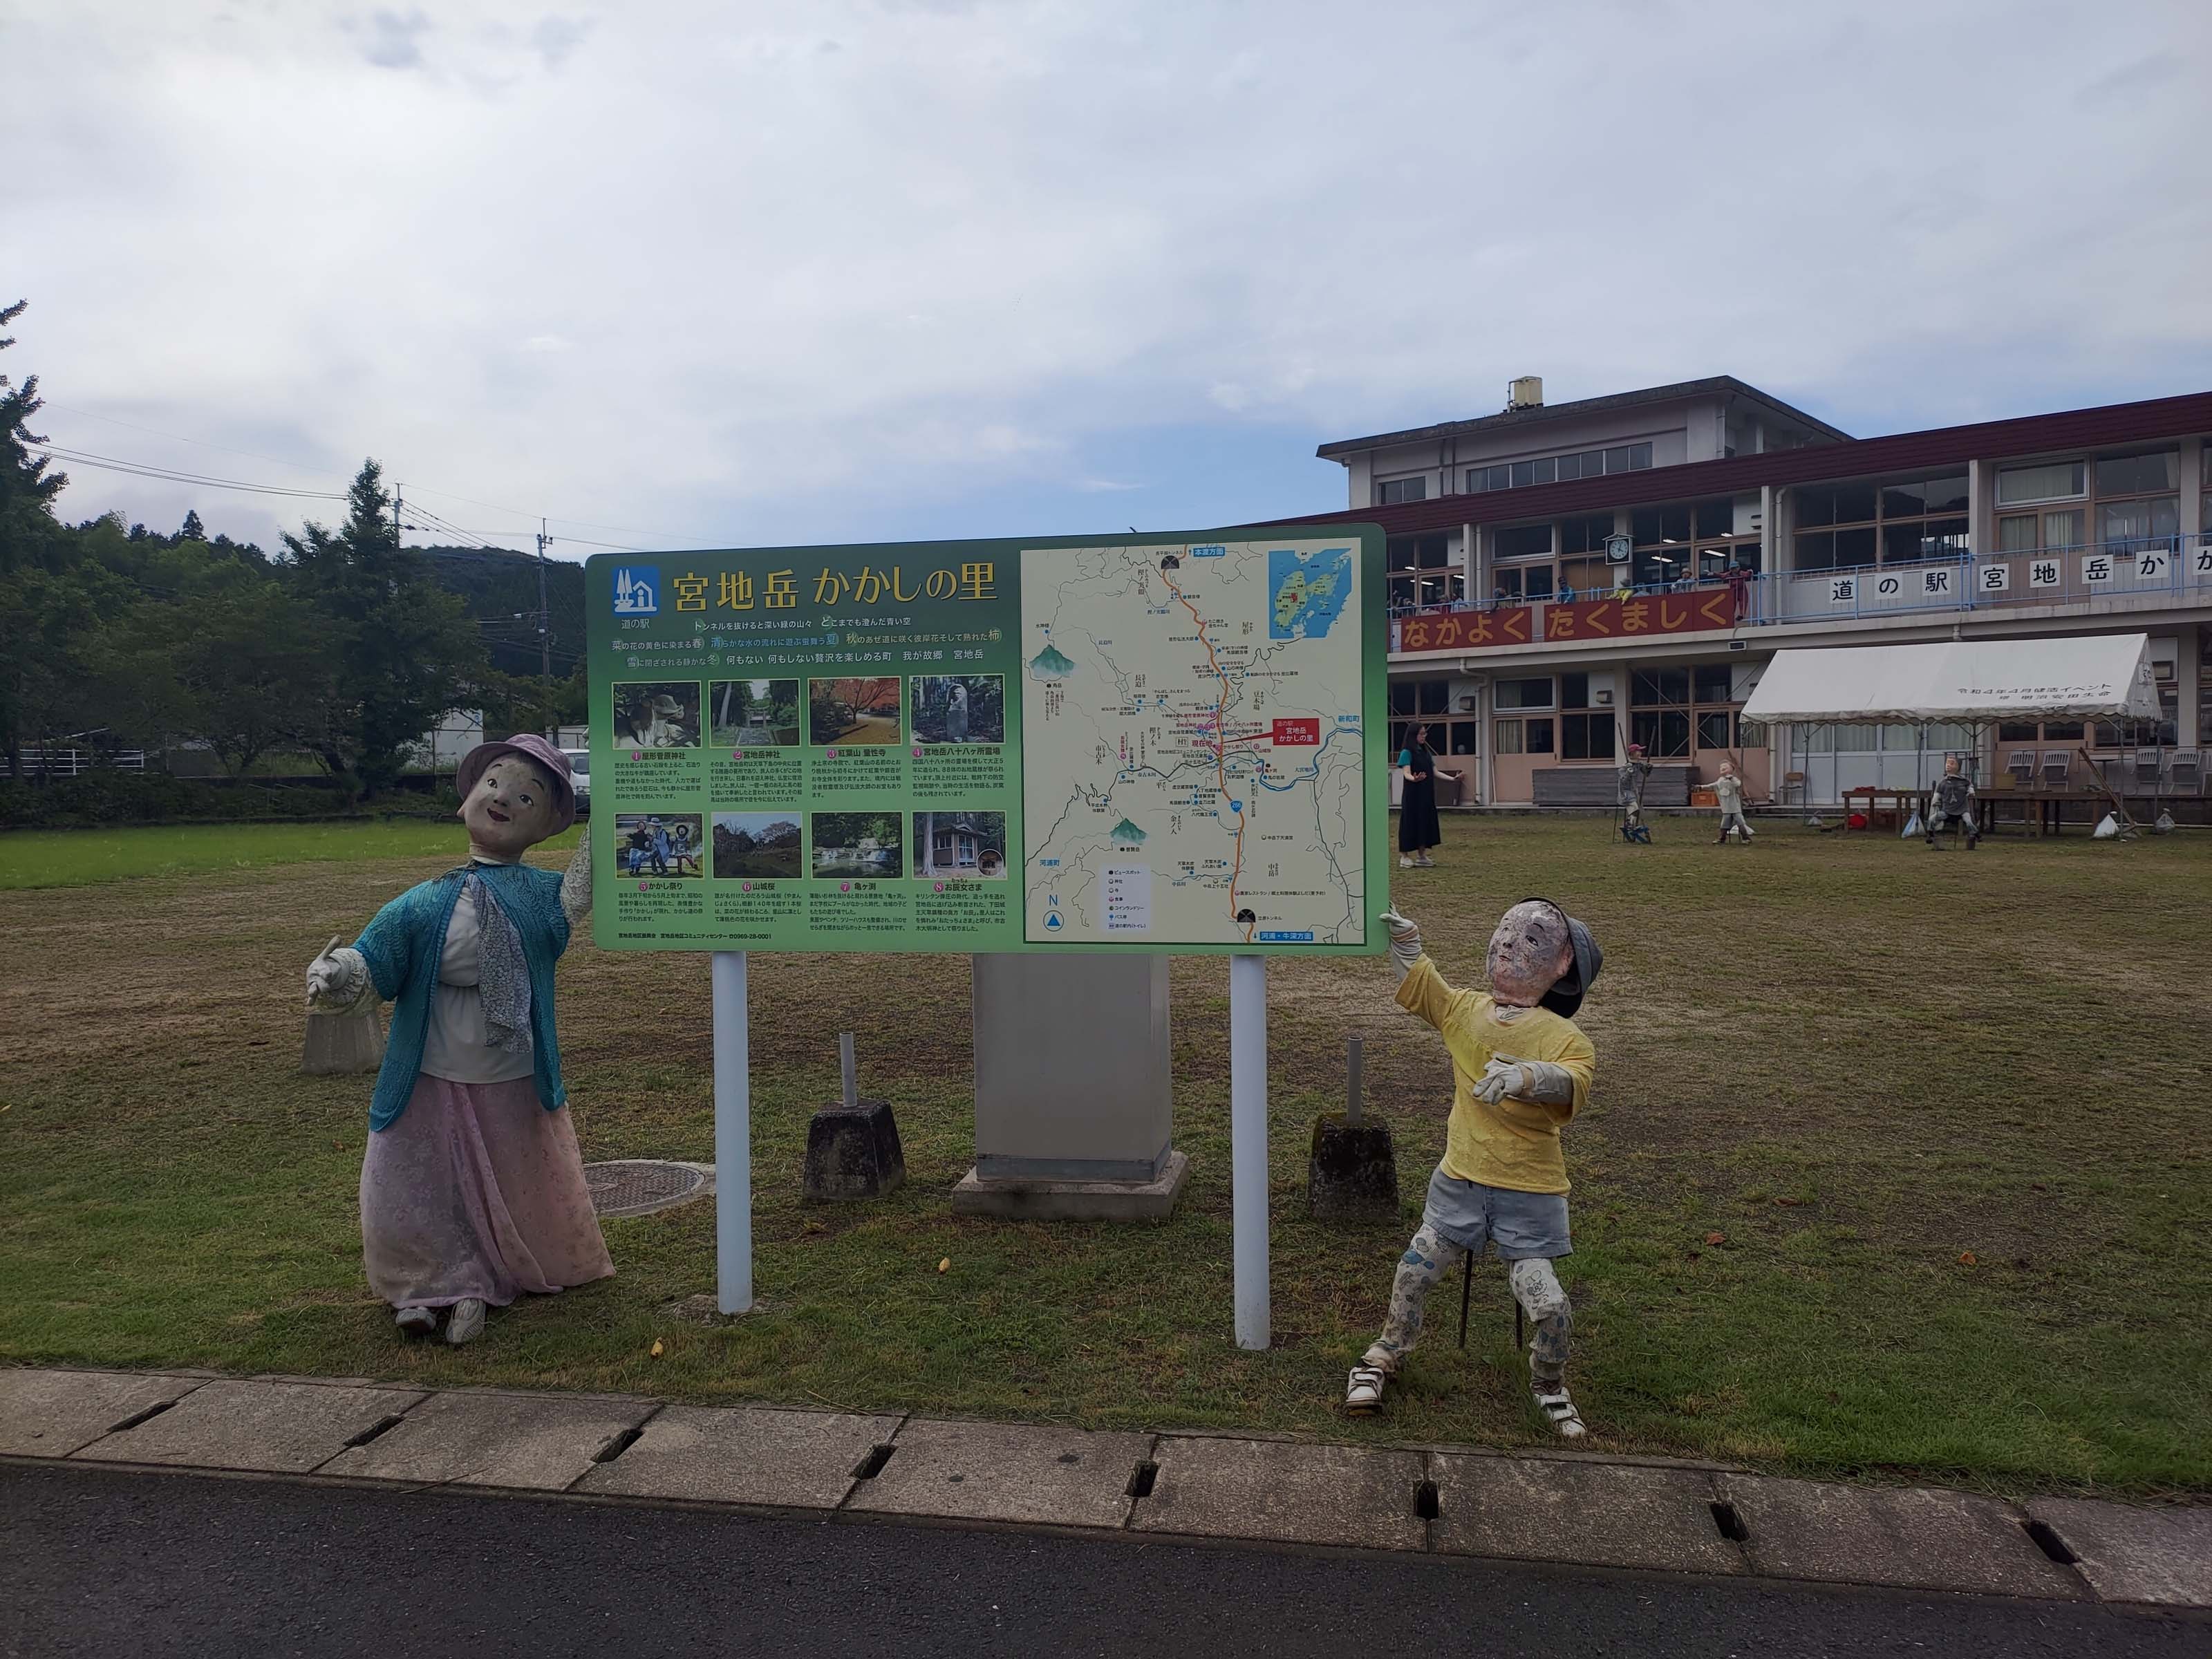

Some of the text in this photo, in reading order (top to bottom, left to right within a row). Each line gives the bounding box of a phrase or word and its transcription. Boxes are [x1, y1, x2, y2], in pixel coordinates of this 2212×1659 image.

[673, 562, 999, 612] 宮地岳 かかしの里
[621, 619, 650, 629] 道の駅
[694, 615, 911, 631] トンネルを抜けると深い緑の山々 どこまでも澄んだ青い空
[1549, 593, 1727, 637] たくましく
[1405, 612, 1526, 648] なかよく
[612, 638, 702, 650] 菜の花の黄色に染まる春
[845, 629, 1000, 644] 秋のあぜ道に咲く彼岸花そして熟れた柿
[627, 648, 984, 668] 雪に閉ざされる静かな冬 何もない 何もしない贅沢を楽しめる町 我が故郷 宮地岳
[743, 751, 780, 759] 宮地岳神社
[753, 882, 776, 890] 山城桜
[1049, 894, 1058, 906] N
